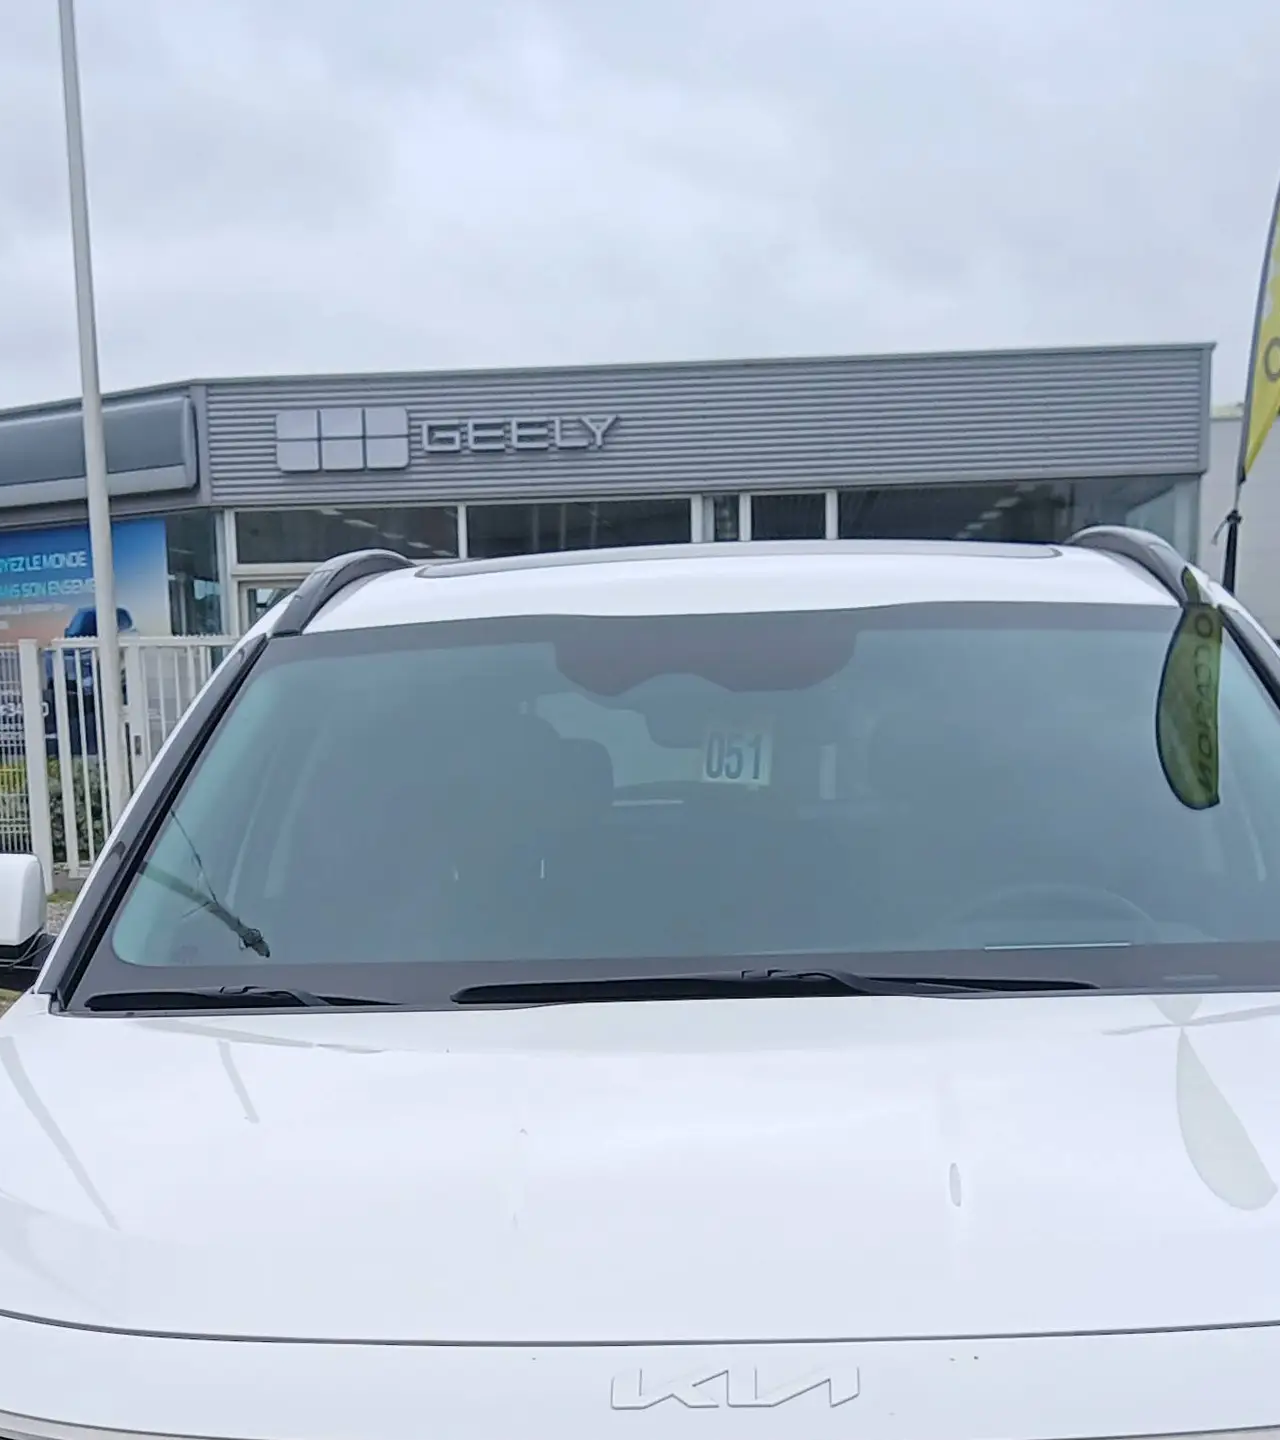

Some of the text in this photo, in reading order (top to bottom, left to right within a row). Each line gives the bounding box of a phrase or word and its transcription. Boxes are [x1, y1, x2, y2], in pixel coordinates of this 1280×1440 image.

[421, 414, 619, 453] GEELY
[26, 554, 42, 571] LE
[42, 551, 89, 570] MONDE
[705, 731, 762, 780] 051
